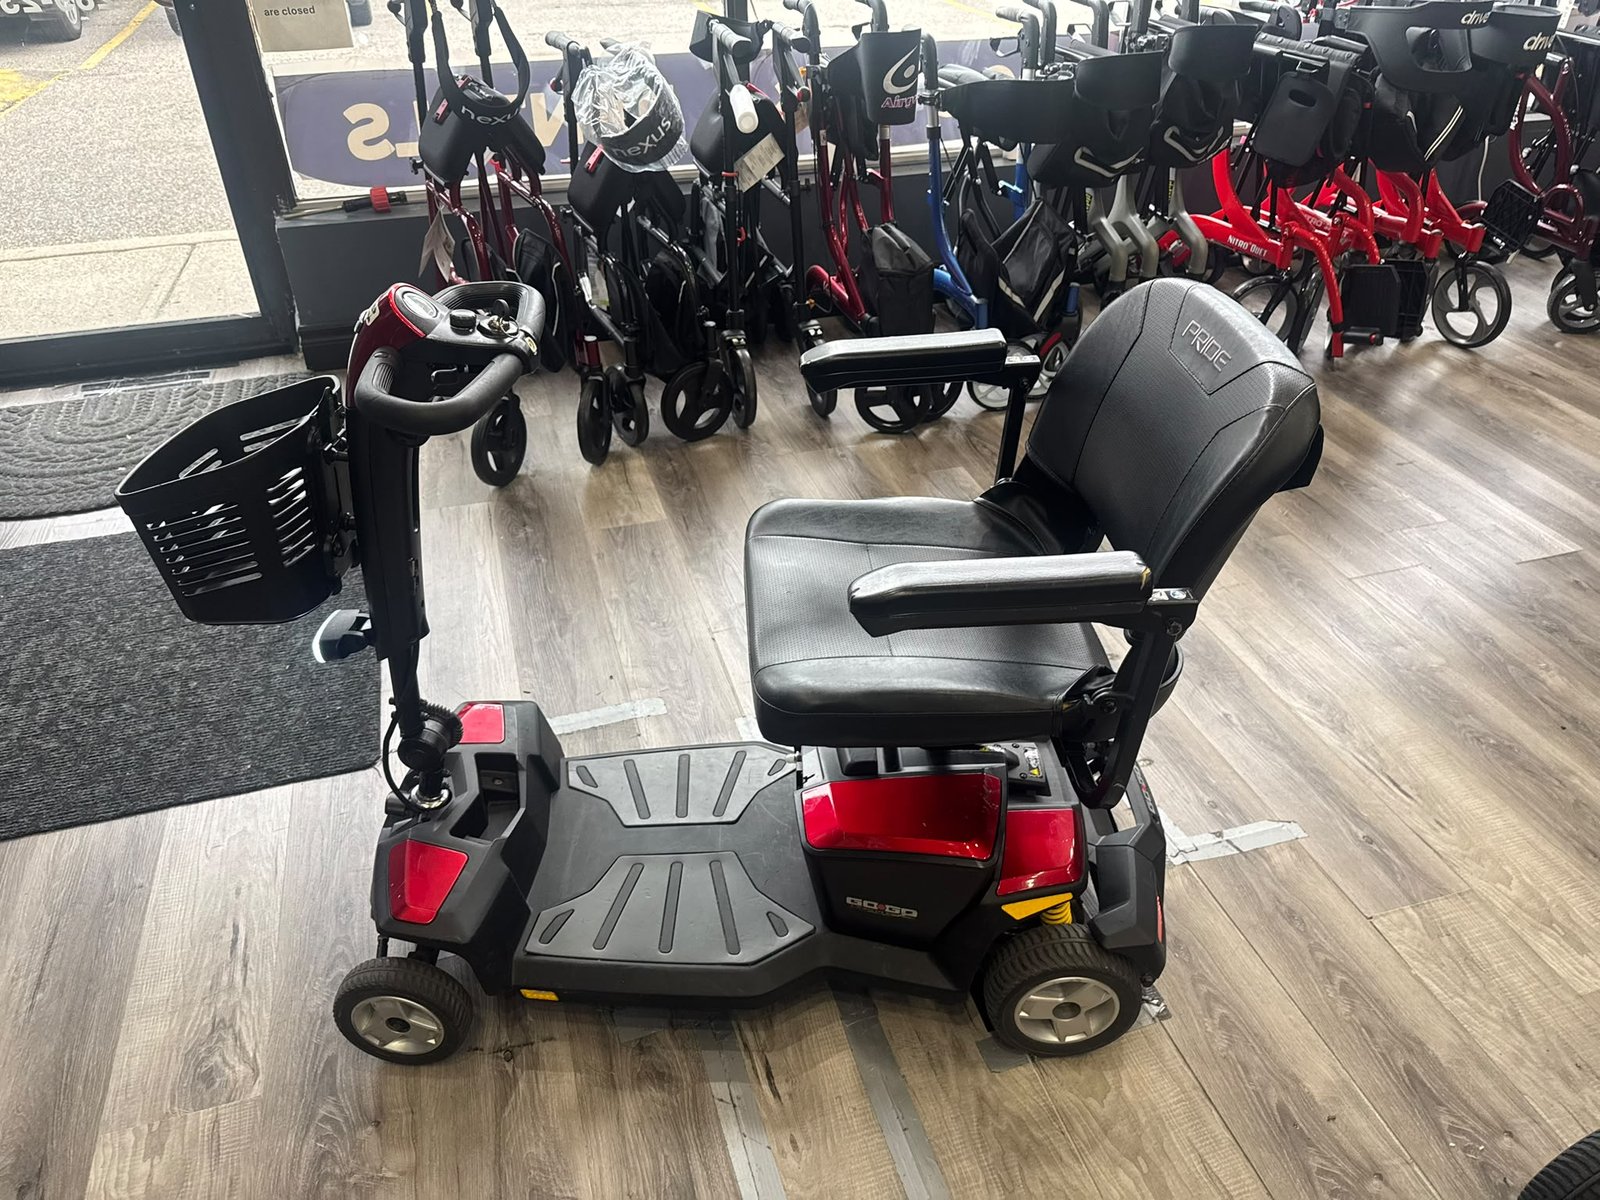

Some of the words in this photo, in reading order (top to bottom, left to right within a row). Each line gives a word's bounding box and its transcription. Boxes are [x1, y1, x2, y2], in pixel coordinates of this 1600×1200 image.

[263, 8, 280, 17] are
[281, 5, 316, 16] closed
[461, 105, 519, 126] nexu
[610, 116, 672, 157] nexus
[1227, 234, 1249, 250] NITRO
[1181, 319, 1232, 372] PRIDE
